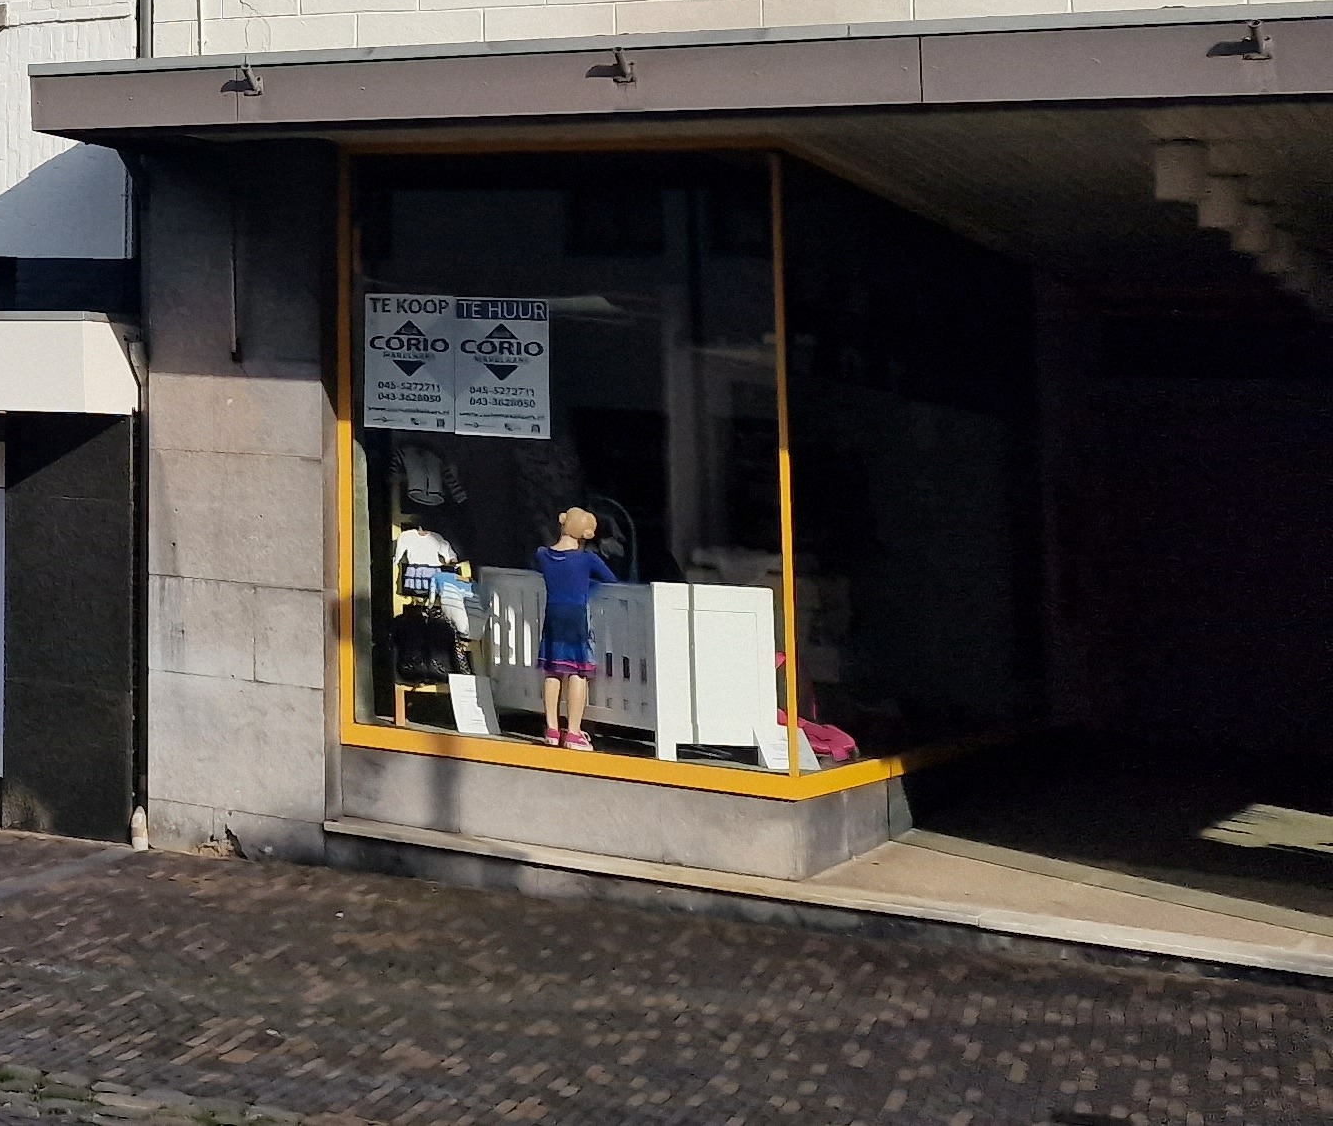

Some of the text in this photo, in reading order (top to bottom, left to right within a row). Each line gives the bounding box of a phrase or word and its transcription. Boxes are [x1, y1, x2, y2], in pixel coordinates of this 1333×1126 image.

[370, 298, 449, 315] TE KOOP
[462, 301, 545, 319] TE HUUR
[370, 336, 449, 352] CORIO
[460, 339, 543, 357] CORIO
